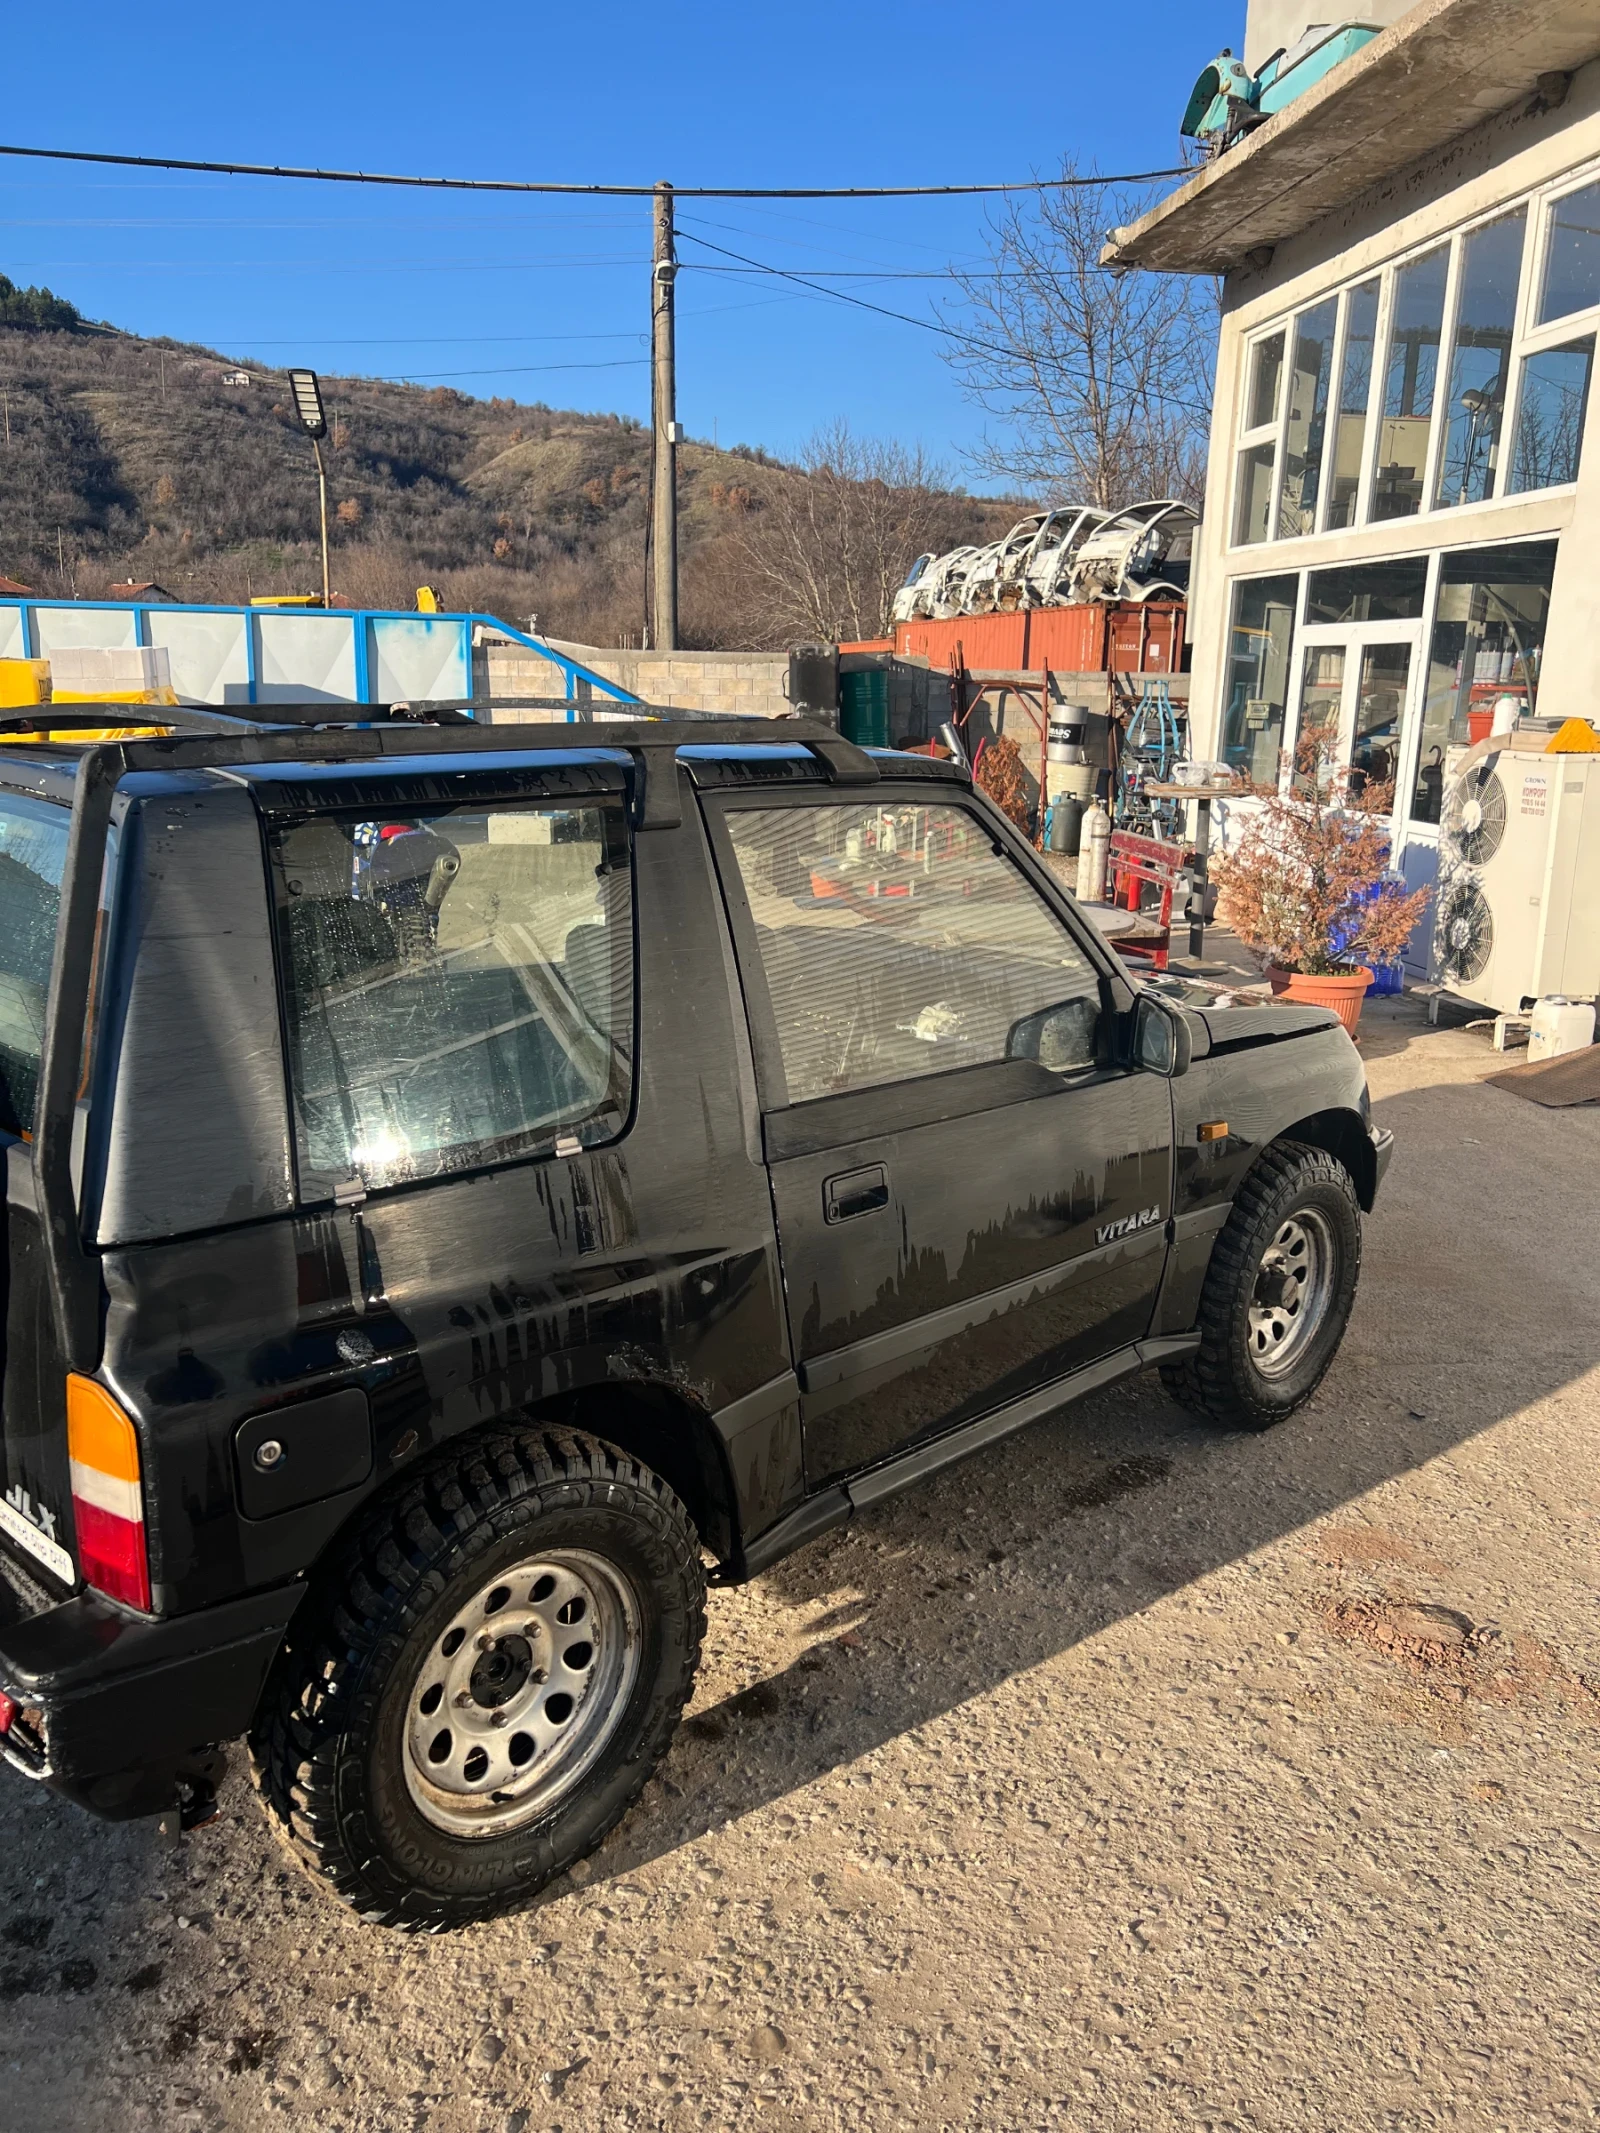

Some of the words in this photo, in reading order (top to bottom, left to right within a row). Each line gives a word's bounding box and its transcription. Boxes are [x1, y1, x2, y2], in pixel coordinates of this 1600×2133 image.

[1095, 1204, 1160, 1244] VITARA
[6, 1484, 56, 1542] JLX
[381, 1802, 503, 1885] LINGLONG
